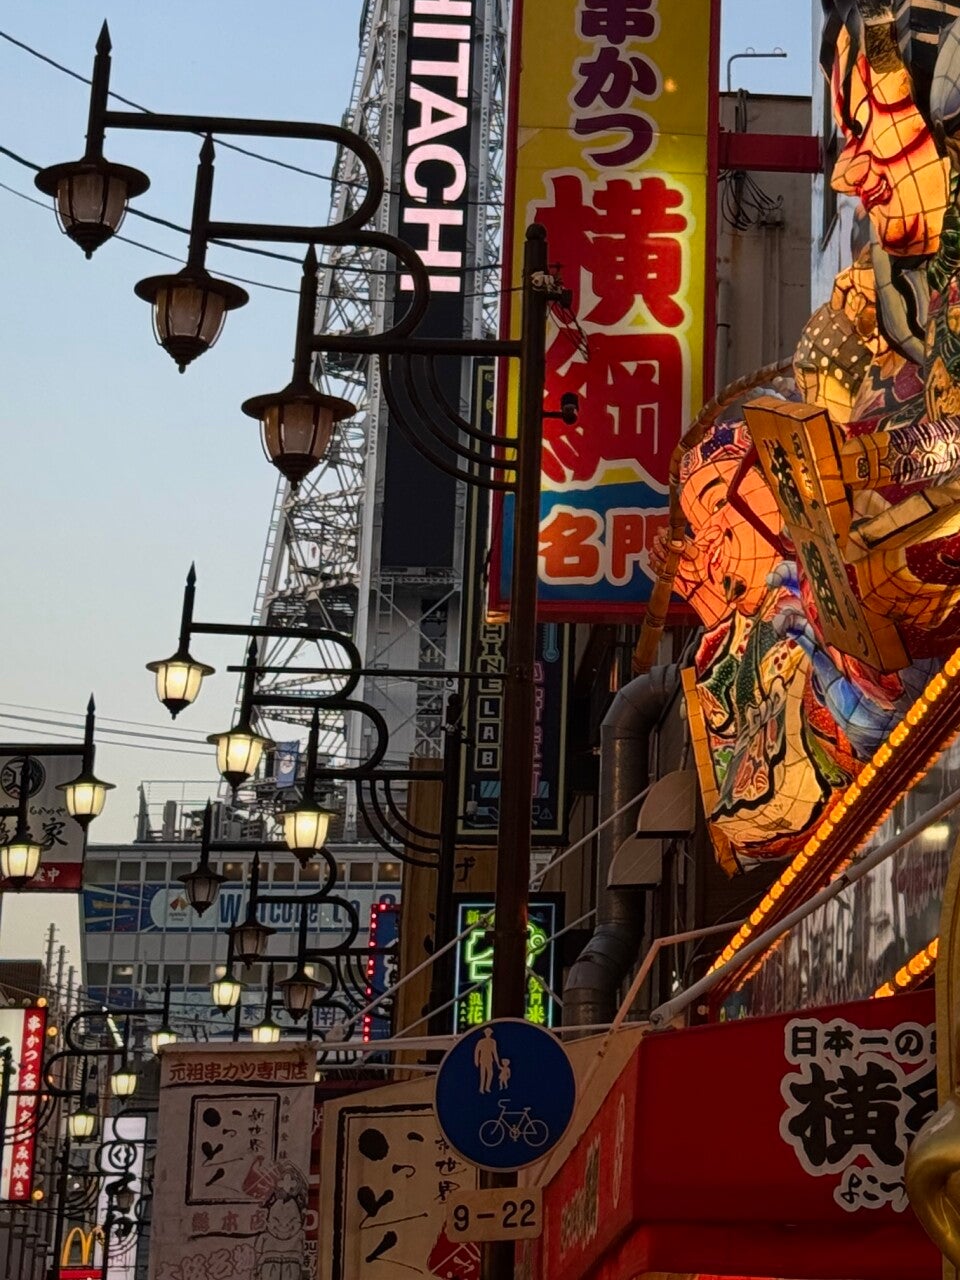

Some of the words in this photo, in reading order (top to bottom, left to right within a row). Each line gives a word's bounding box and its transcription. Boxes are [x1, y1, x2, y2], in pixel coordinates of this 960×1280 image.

[535, 174, 688, 487] 横綱
[480, 699, 497, 767] LAB
[792, 1025, 937, 1059] 日本一の
[169, 1061, 309, 1082] 元祖串カツ専門店
[453, 1199, 536, 1232] 9-22
